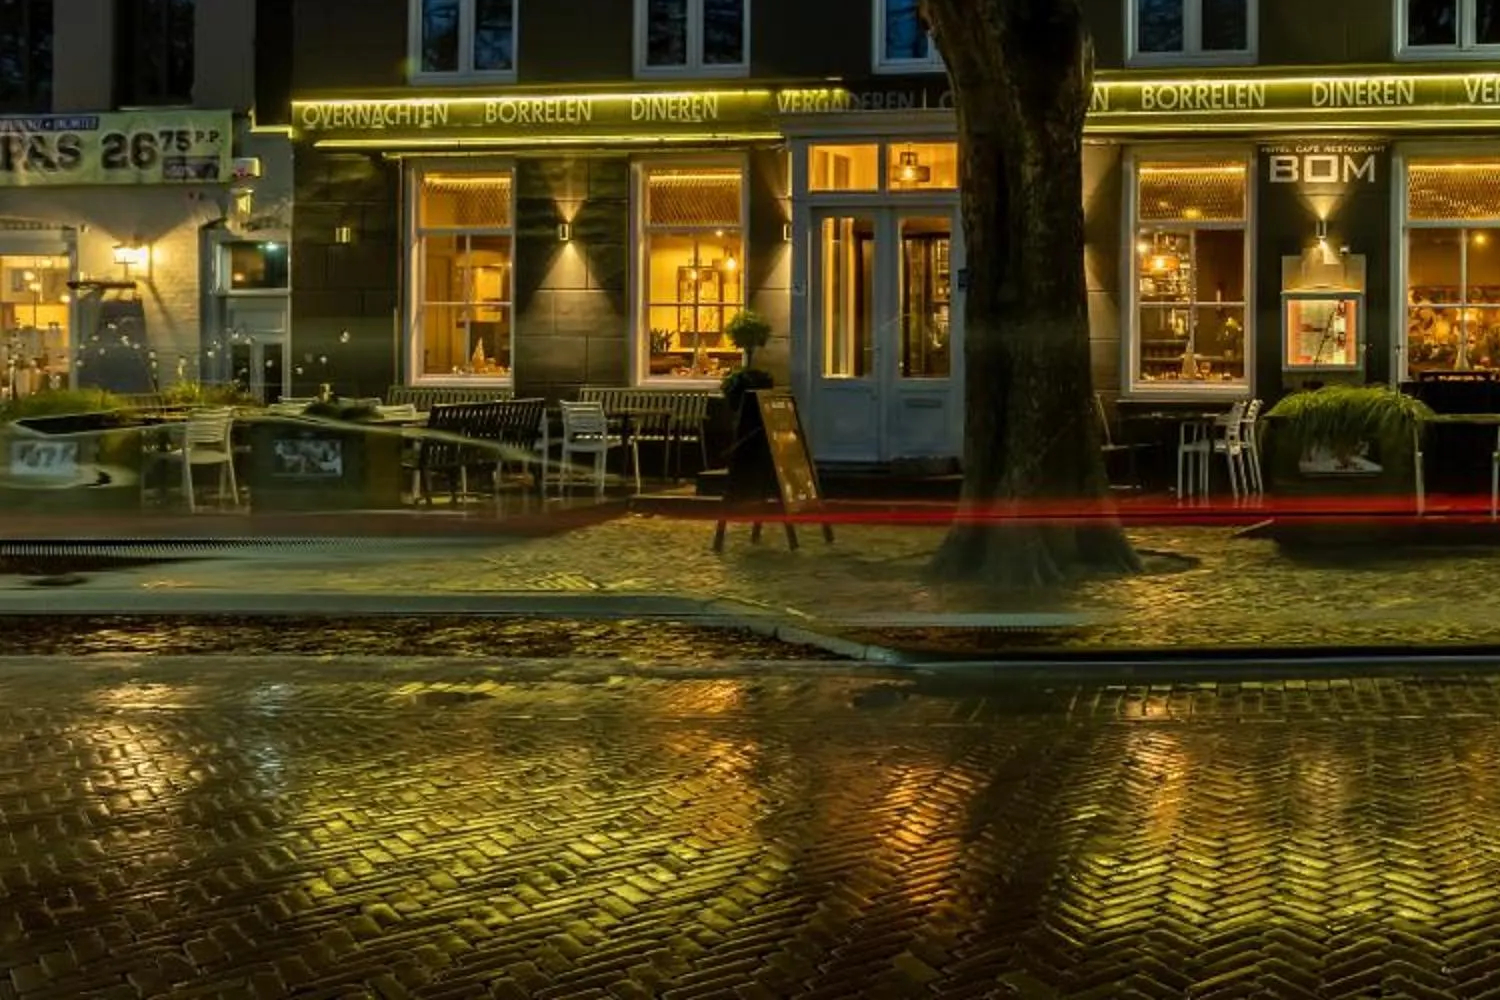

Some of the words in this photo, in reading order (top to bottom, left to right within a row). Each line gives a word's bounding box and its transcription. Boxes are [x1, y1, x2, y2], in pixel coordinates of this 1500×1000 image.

[302, 103, 448, 127] OVERNACHTEN
[485, 98, 592, 123] BORRELEN
[631, 93, 718, 121] DINEREN
[1141, 82, 1265, 110] BORRELEN
[1311, 79, 1415, 107] DINEREN
[1269, 154, 1375, 183] BOM
